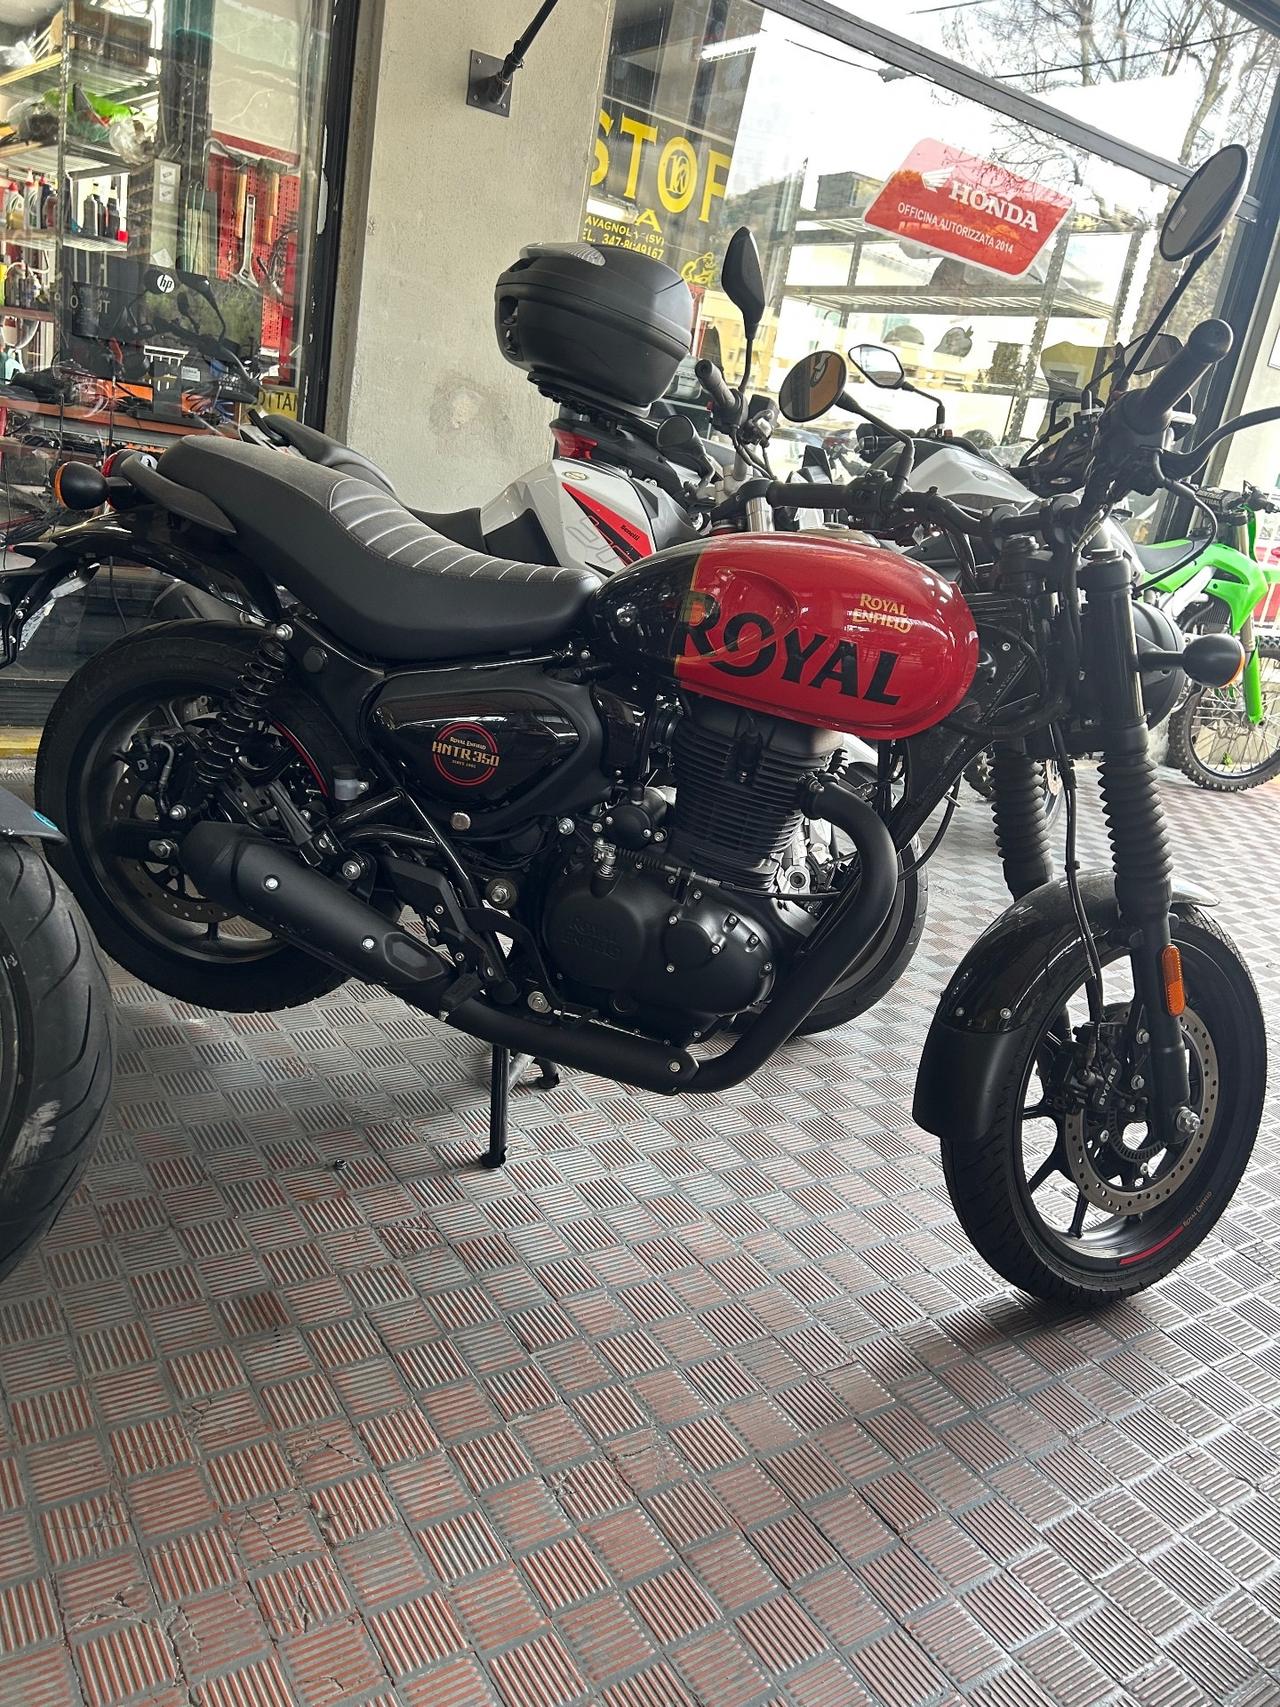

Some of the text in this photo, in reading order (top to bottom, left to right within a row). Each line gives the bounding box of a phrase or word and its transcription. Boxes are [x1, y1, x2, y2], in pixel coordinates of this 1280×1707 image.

[949, 181, 1038, 232] HONDA
[898, 202, 1014, 254] OFFICINA AUTORIZZATA 2014
[158, 274, 174, 293] hp
[860, 593, 907, 616] ROYAL
[853, 608, 912, 633] ENFIELD
[672, 590, 901, 706] ROYAL
[432, 741, 471, 760] HNTR
[472, 751, 499, 766] 350
